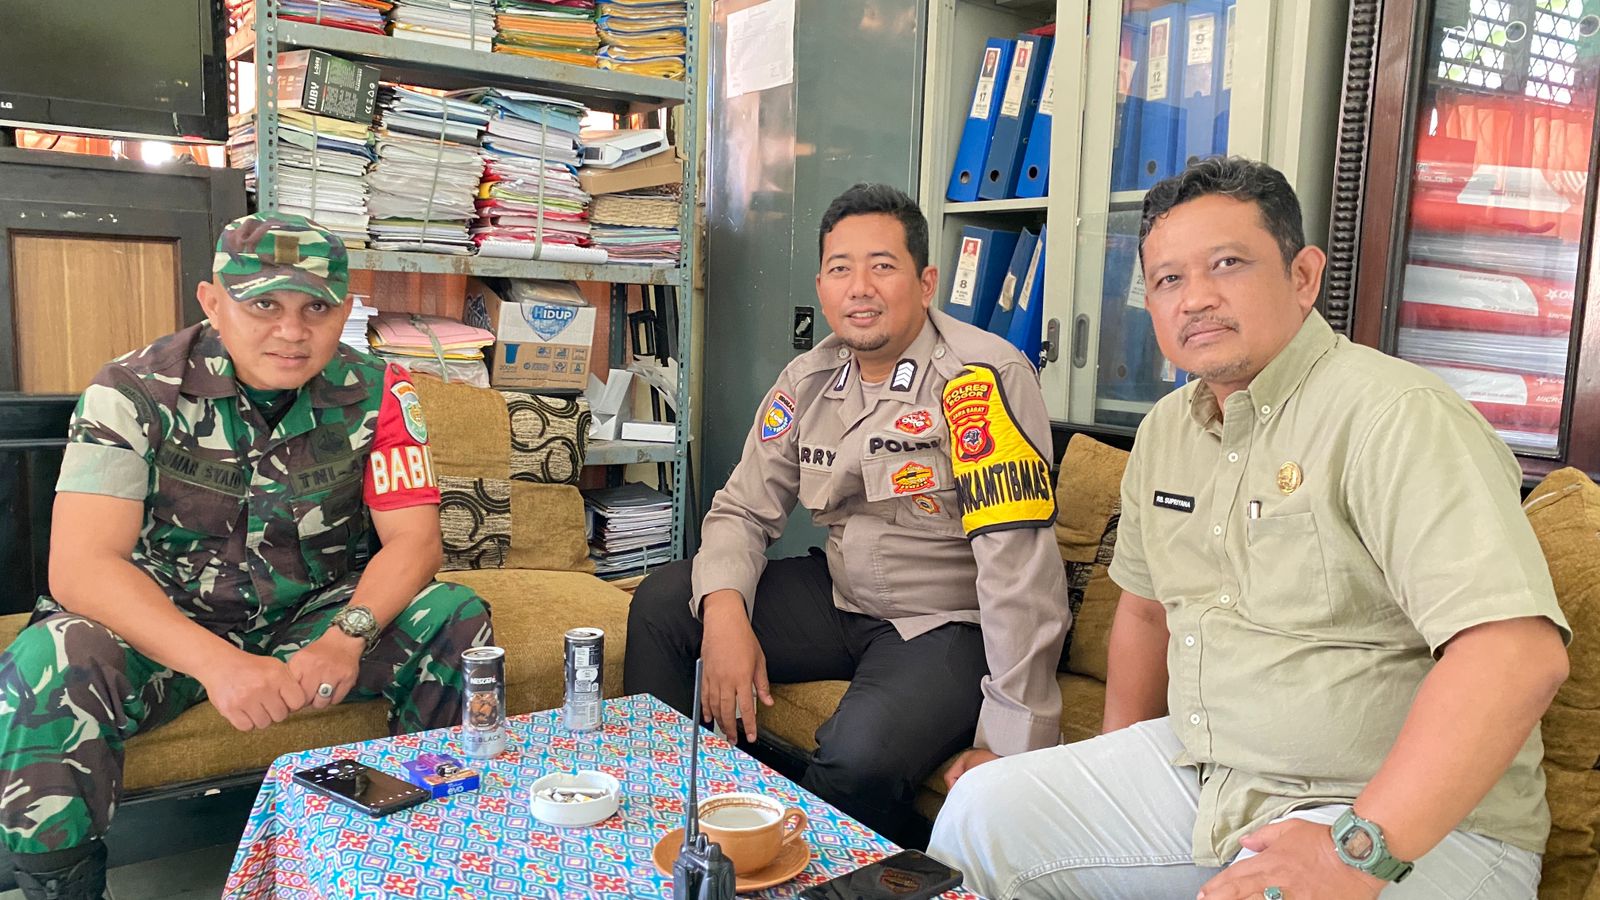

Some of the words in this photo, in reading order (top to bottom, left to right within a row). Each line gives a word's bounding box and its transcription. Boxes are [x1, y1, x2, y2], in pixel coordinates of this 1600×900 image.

[1195, 33, 1205, 45] 9
[308, 82, 320, 110] LUBY
[979, 92, 987, 102] 17
[1, 101, 13, 109] LG
[960, 280, 967, 289] 8
[534, 304, 572, 320] HIDUP
[946, 384, 988, 404] POLRES
[949, 391, 984, 407] BOGOR
[371, 445, 438, 495] BABI
